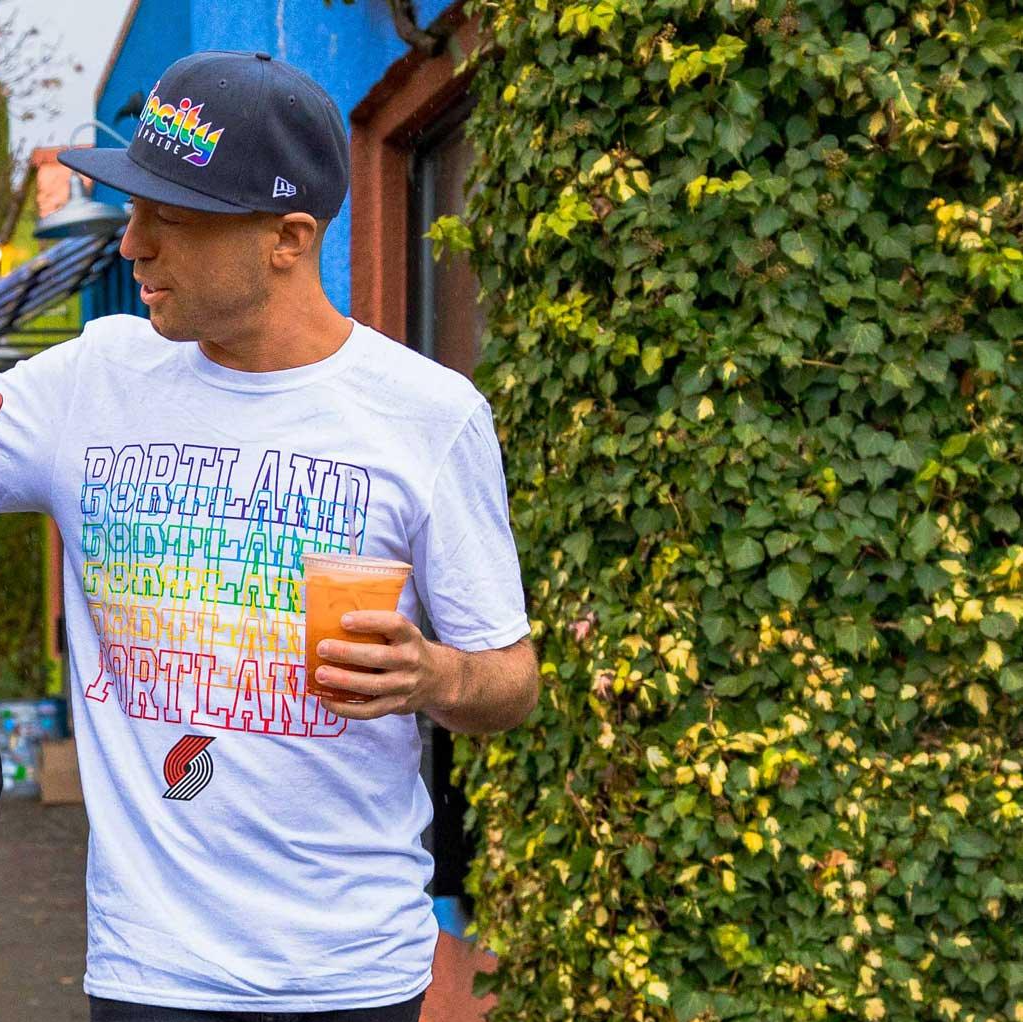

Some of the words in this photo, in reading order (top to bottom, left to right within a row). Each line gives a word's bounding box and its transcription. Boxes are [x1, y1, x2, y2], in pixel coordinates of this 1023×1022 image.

[138, 80, 225, 167] pcity
[143, 129, 181, 155] PRIDE
[81, 443, 372, 538] PORTLAND
[81, 523, 352, 613] PORTLAN
[82, 561, 307, 655] PORTLAN
[86, 601, 318, 698] PORTLAN
